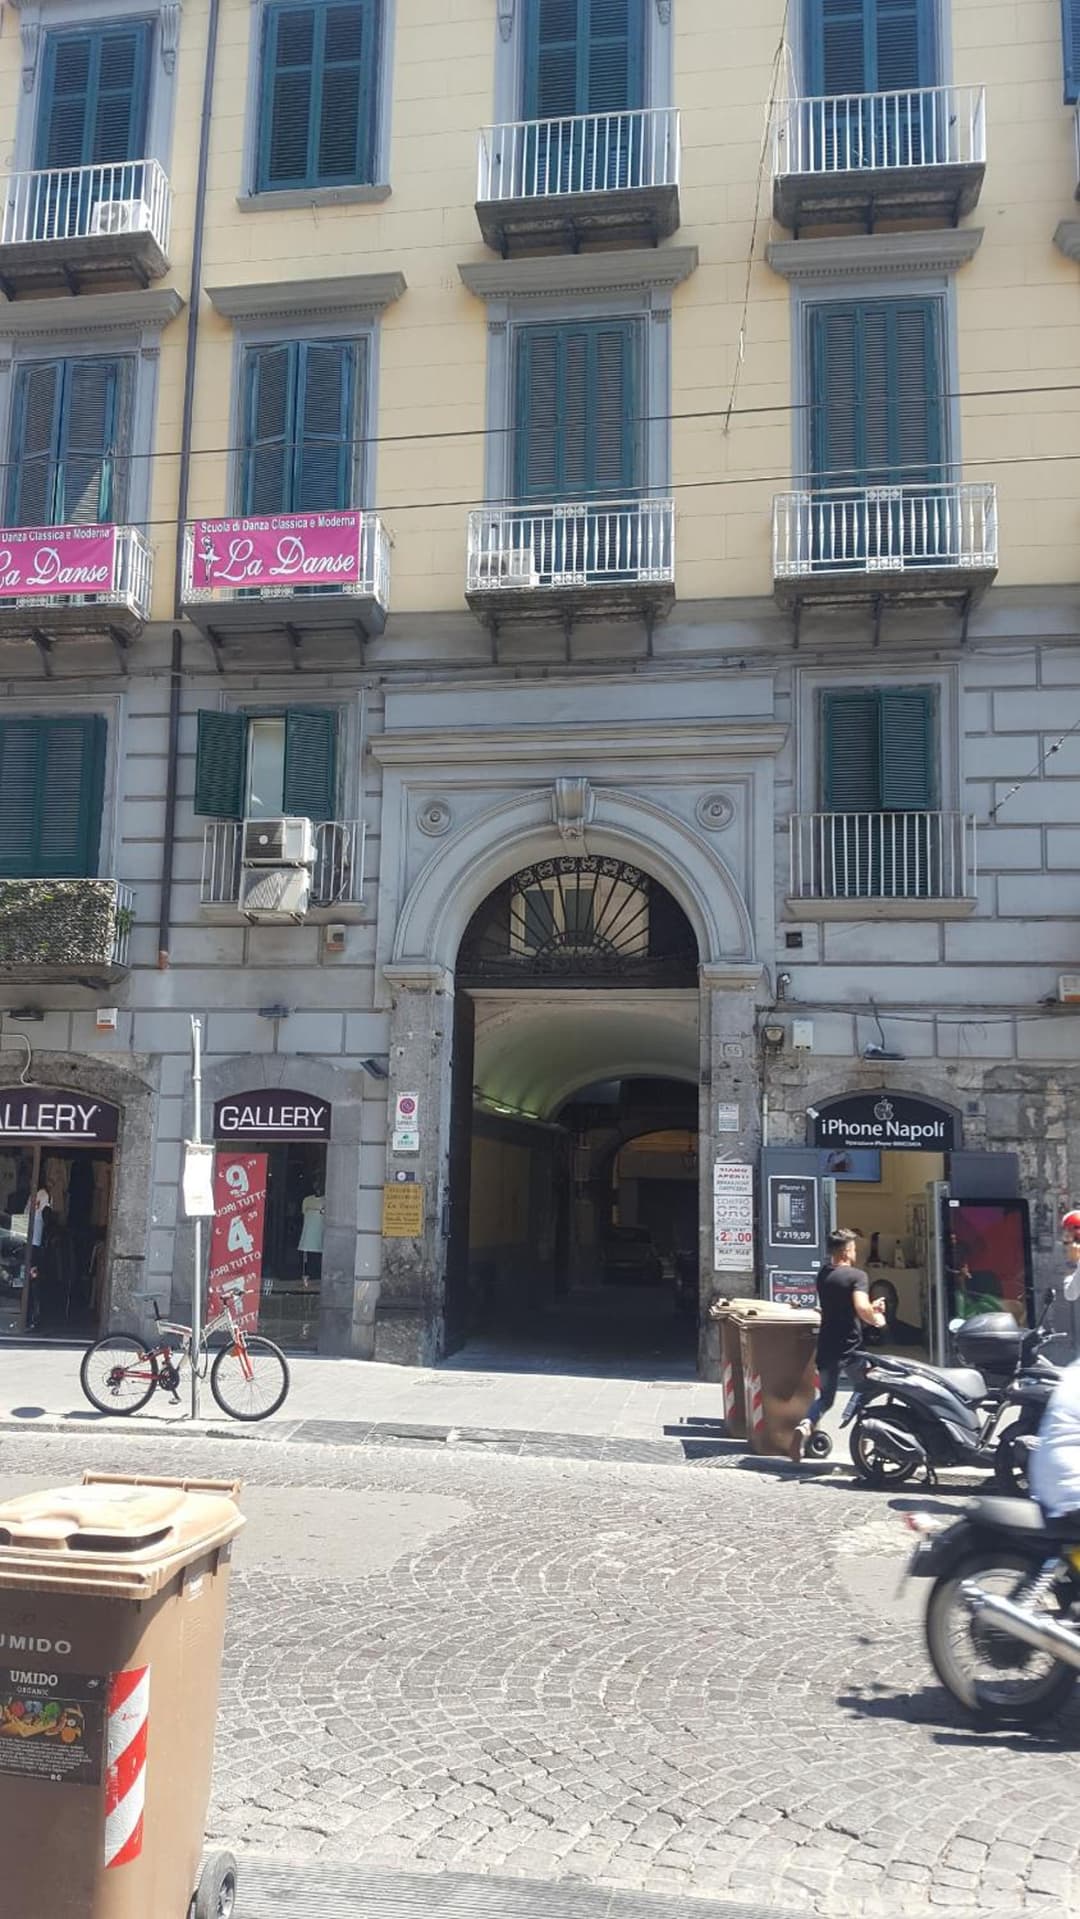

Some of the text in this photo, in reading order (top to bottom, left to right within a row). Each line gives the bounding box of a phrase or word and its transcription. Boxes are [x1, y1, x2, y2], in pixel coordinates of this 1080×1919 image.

[28, 530, 65, 541] Classica
[65, 531, 71, 539] e
[72, 528, 110, 540] Moderna
[201, 515, 355, 533] Scuola di Danza Classica e Moderna
[26, 547, 109, 585] Danse
[213, 536, 355, 582] La Danse
[0, 1103, 98, 1131] LLERY
[219, 1106, 324, 1131] GALLERY
[822, 1119, 883, 1136] iPhone
[228, 1215, 254, 1254] 4
[230, 1250, 262, 1270] TUTTO
[10, 1670, 58, 1687] UMIDO
